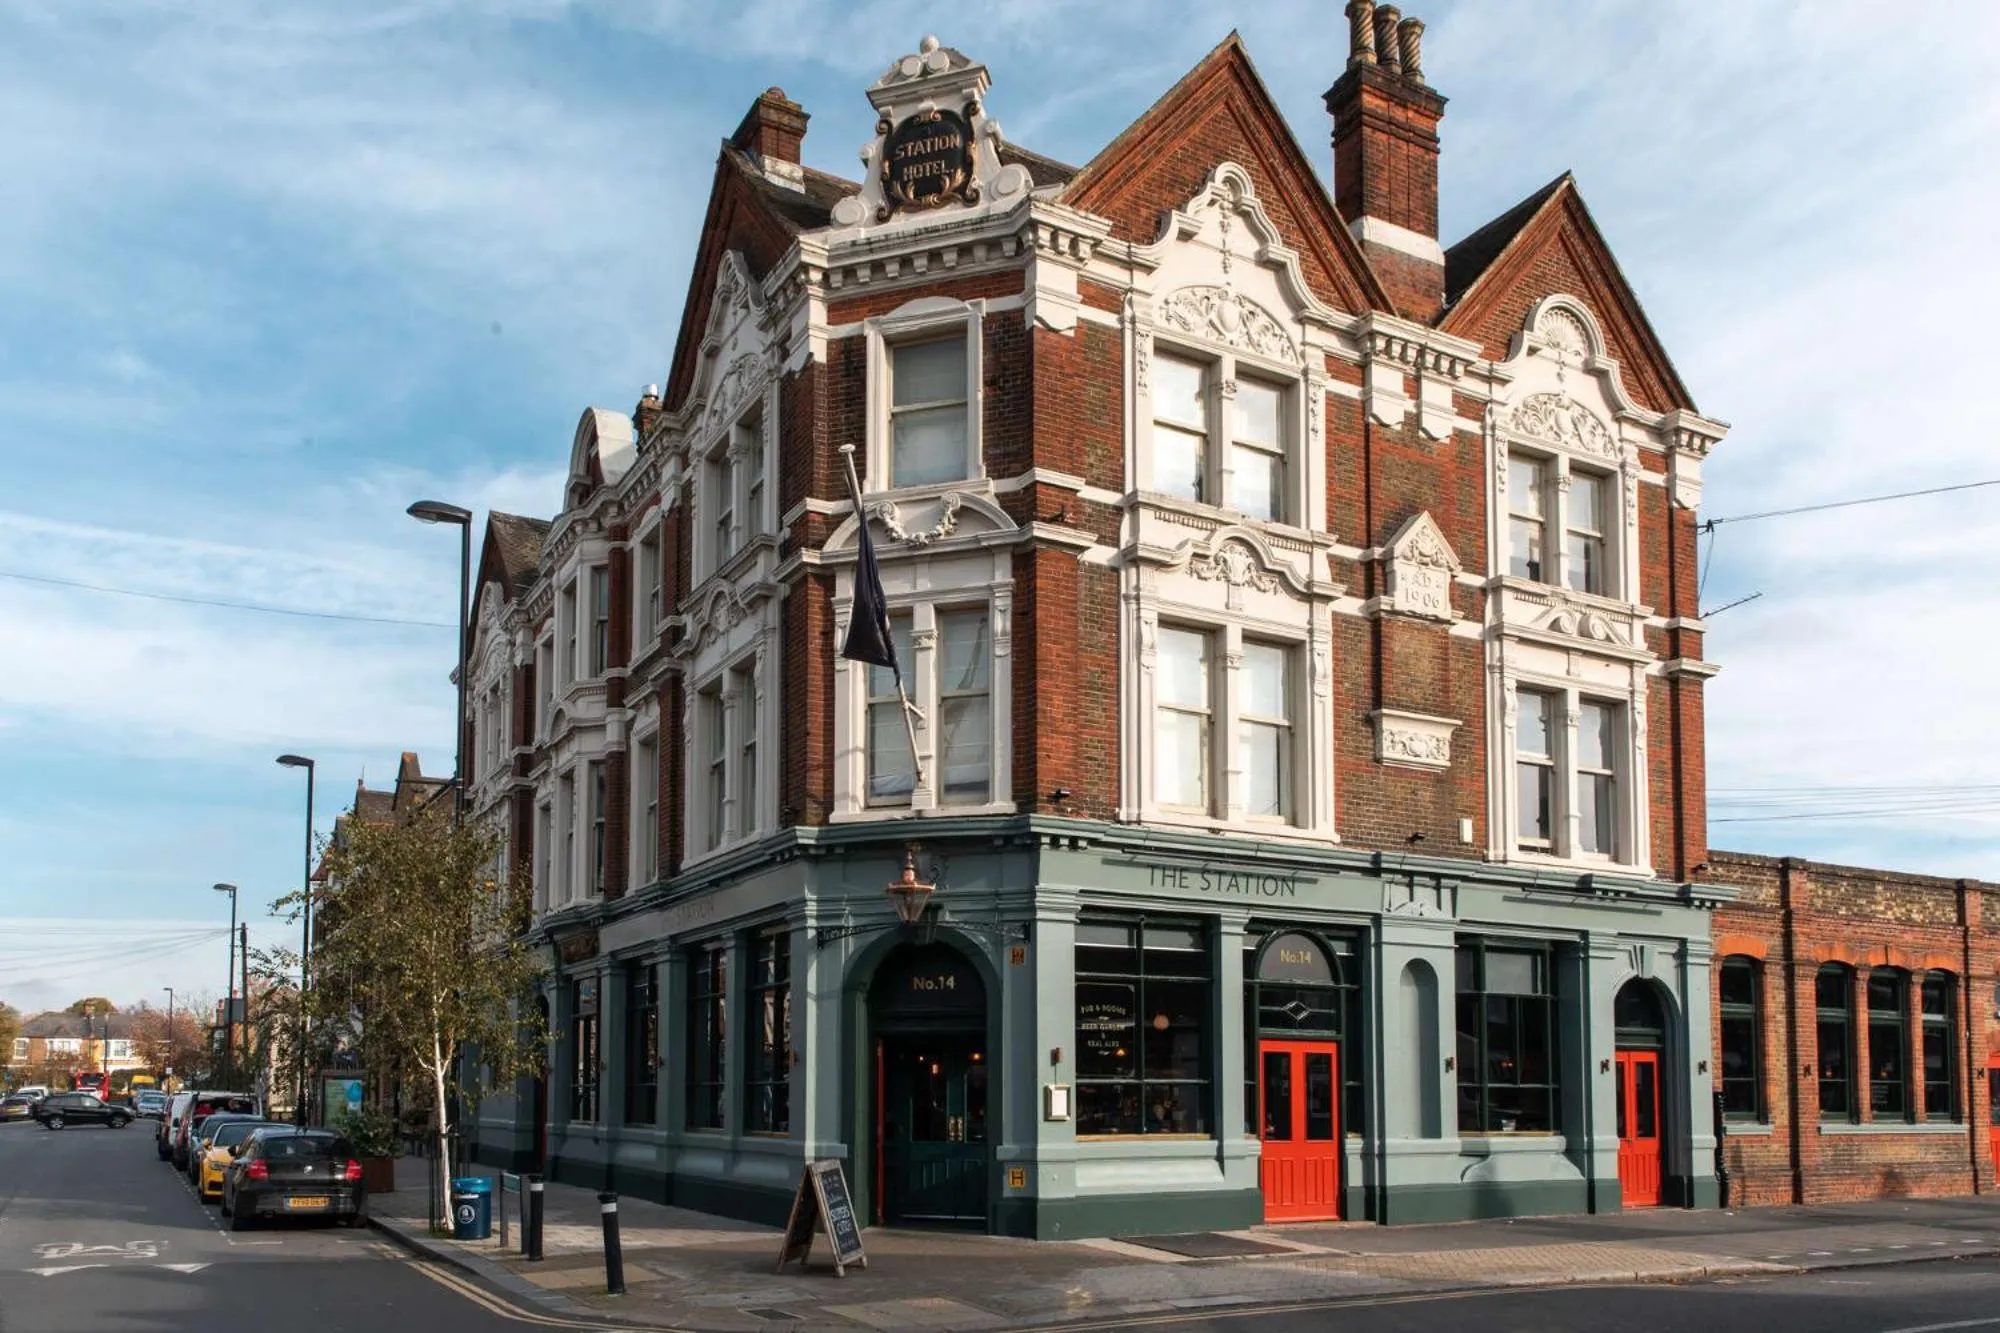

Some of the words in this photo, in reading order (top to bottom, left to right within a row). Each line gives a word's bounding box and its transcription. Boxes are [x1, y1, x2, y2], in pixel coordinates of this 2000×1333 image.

[894, 133, 961, 161] STATION
[1147, 864, 1190, 889] THE
[1200, 867, 1296, 897] STATION
[912, 974, 956, 991] No.14
